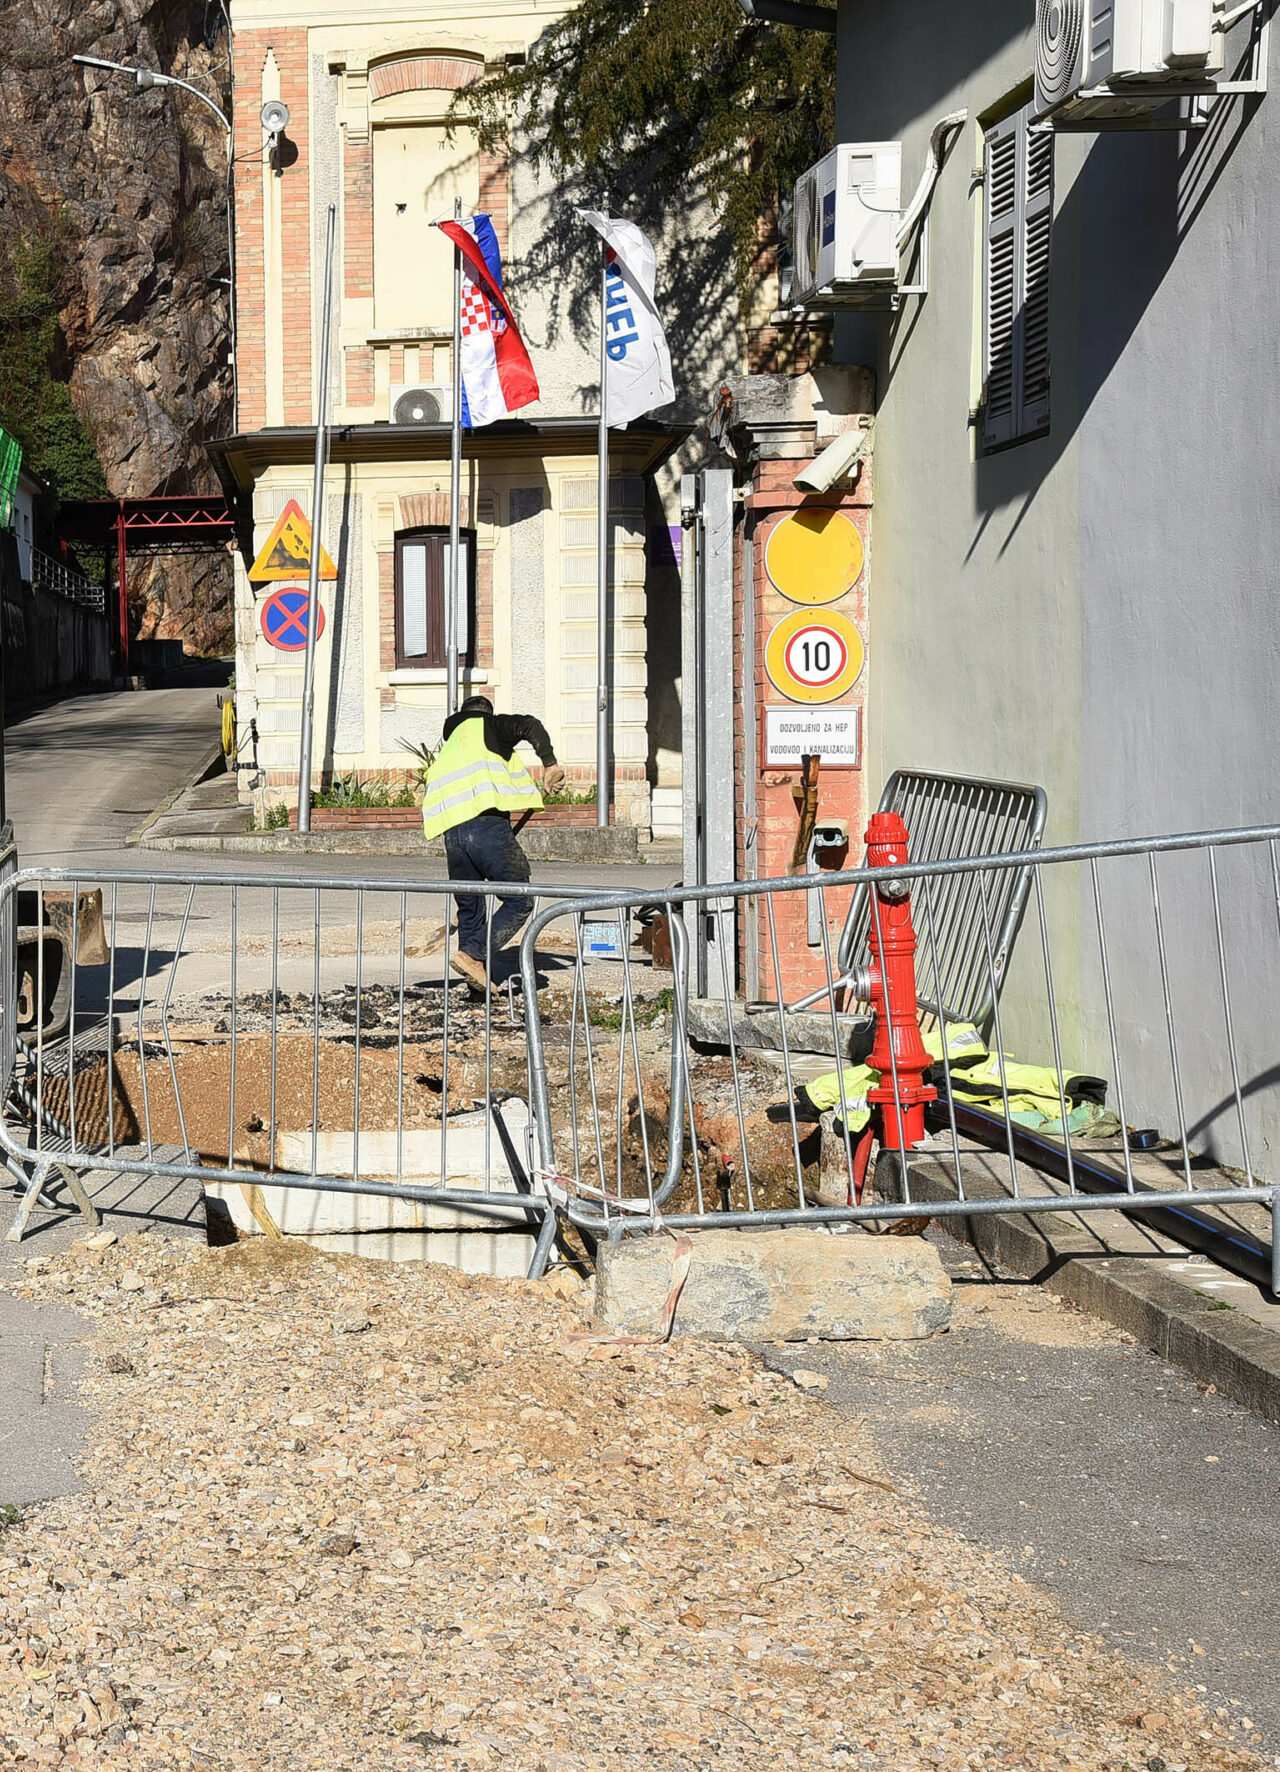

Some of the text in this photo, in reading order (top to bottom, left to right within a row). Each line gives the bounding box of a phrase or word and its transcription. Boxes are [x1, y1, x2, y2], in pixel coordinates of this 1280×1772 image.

[802, 641, 831, 671] 10
[779, 723, 848, 733] DOZVOLJENO ZA HEP
[770, 745, 801, 754] VODOVOD
[809, 745, 854, 754] KANALIZACIJU
